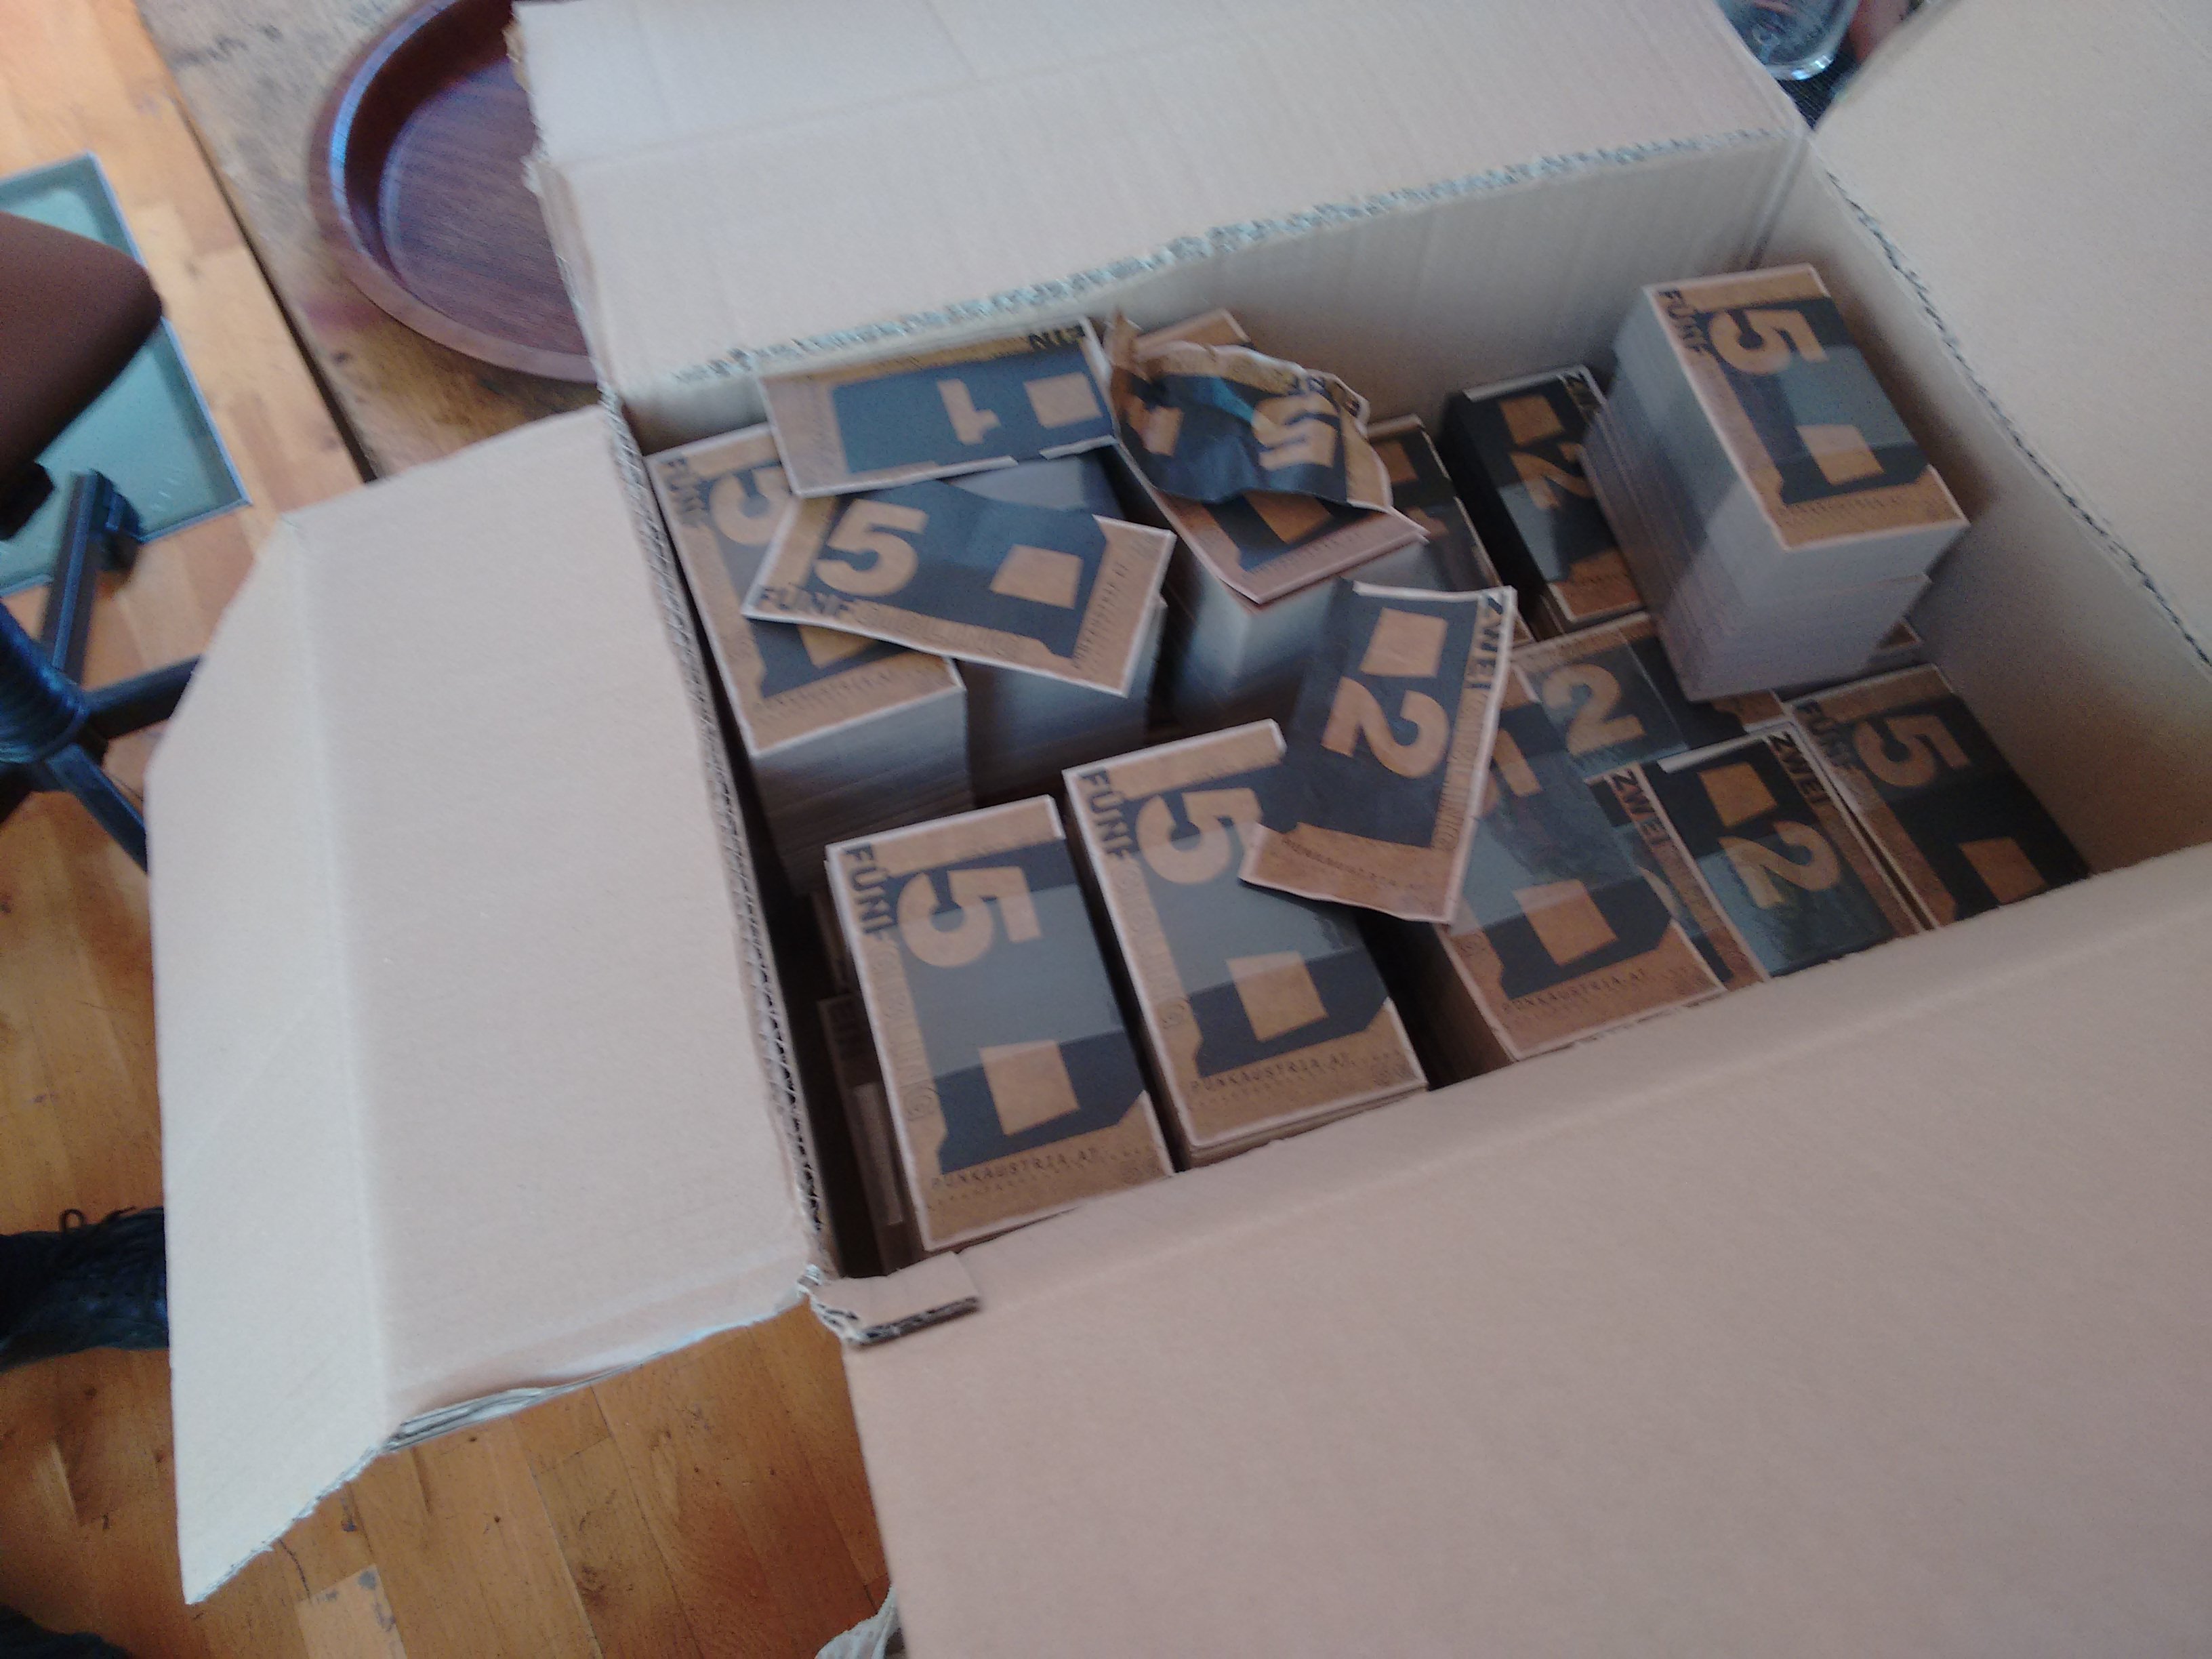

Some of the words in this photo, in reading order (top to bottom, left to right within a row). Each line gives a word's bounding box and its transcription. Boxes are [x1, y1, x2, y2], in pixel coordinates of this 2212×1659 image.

[1709, 309, 1828, 376] 5
[937, 378, 1000, 445] 1
[1252, 392, 1339, 470] 5
[813, 497, 929, 596] 5
[1322, 676, 1450, 779] 2
[1542, 663, 1645, 756] 2
[1854, 715, 1972, 787] 5
[1610, 768, 1672, 847] ZWEI
[1767, 731, 1827, 806] ZWEI
[1135, 787, 1263, 884] 5
[1719, 820, 1839, 909] 2
[896, 865, 1043, 968] 5
